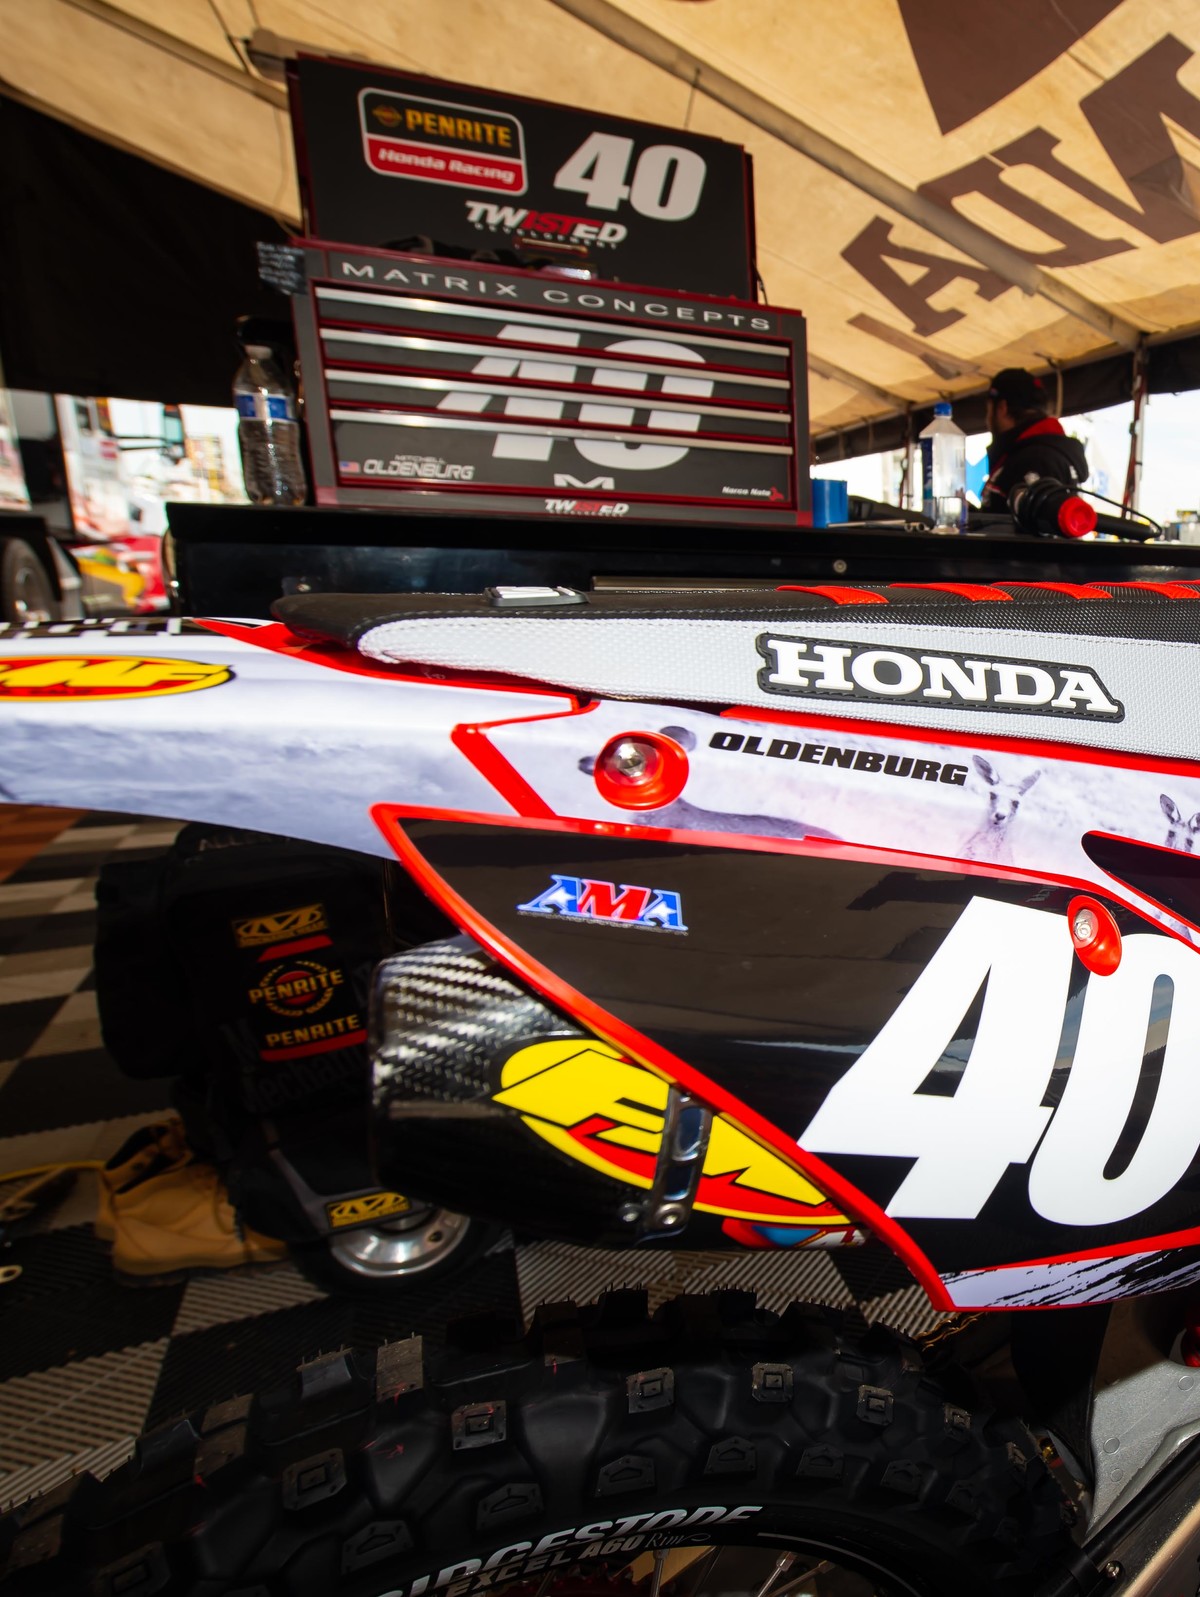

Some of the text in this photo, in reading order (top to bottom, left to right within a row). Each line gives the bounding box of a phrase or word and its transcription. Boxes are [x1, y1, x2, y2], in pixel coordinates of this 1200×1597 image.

[405, 108, 513, 148] PENRITE
[378, 147, 516, 185] Honda Racing
[553, 131, 707, 222] 40
[465, 200, 628, 243] TWISTED
[342, 262, 518, 298] MATRIX
[542, 289, 771, 331] CONCEPTS
[363, 459, 475, 480] OLDENBURG
[767, 638, 1119, 714] HONDA
[708, 731, 970, 787] OLDENBURG
[516, 874, 689, 932] AMA
[248, 968, 346, 1005] PENRITE
[265, 1013, 361, 1048] PENRITE
[445, 1549, 572, 1597] EXCEL
[577, 1533, 646, 1561] A60
